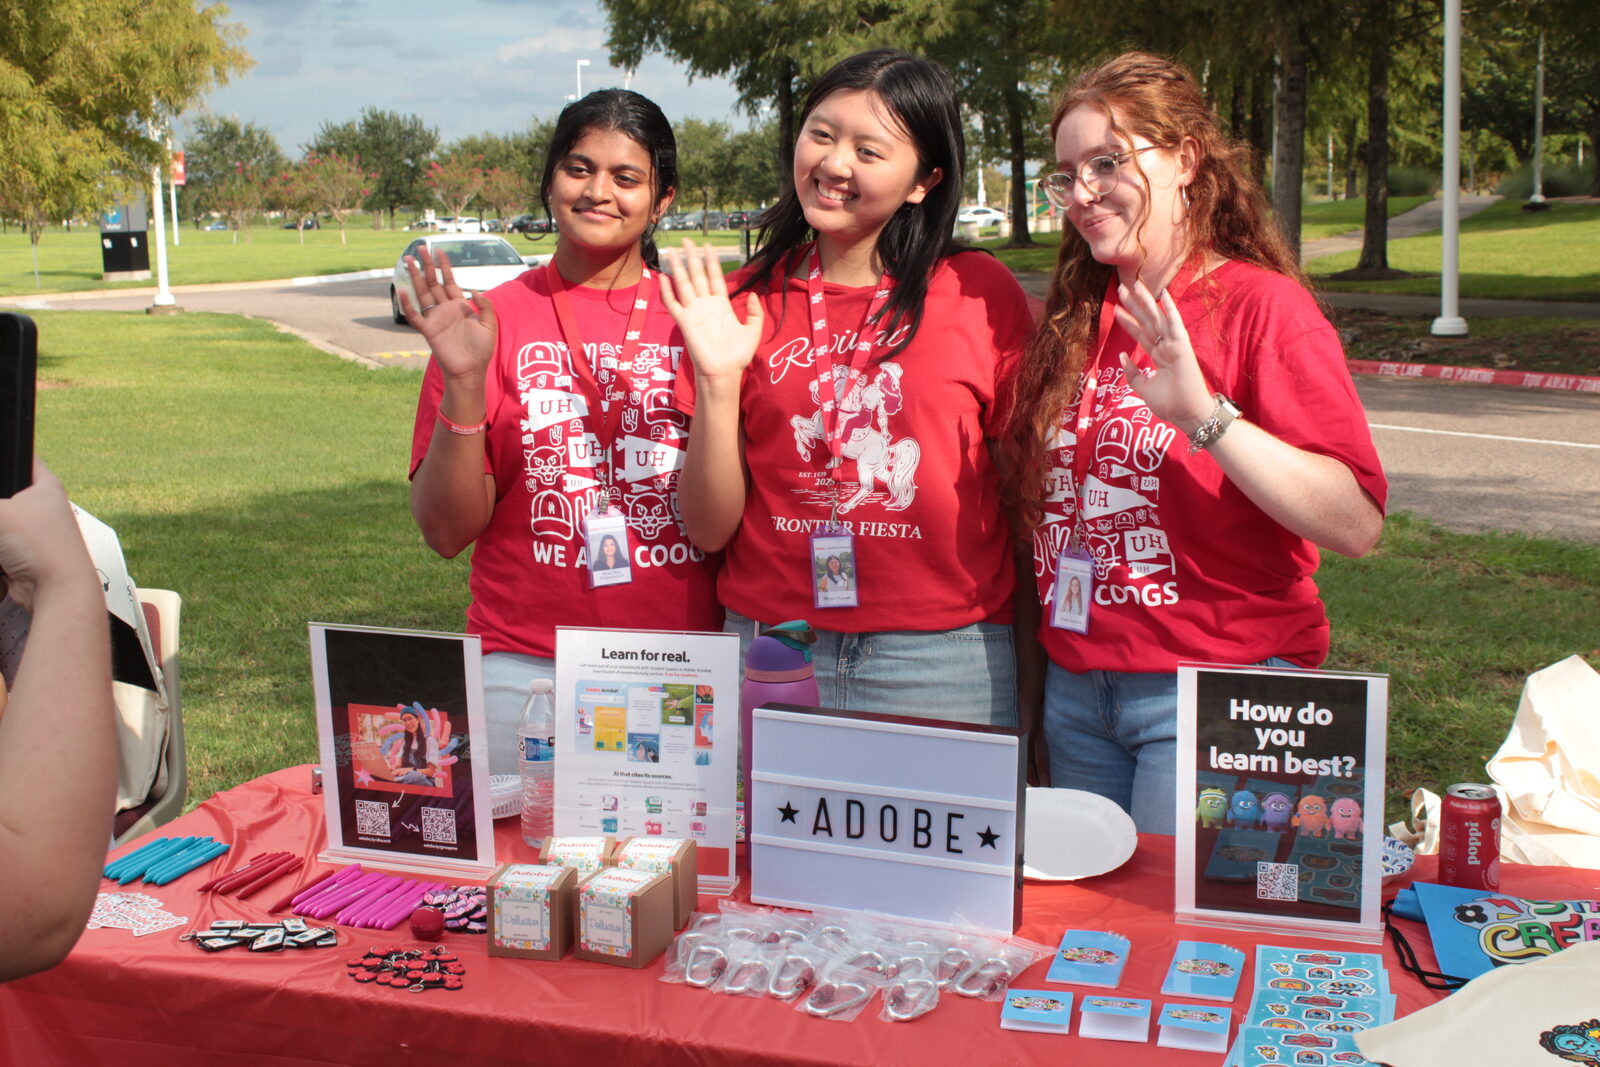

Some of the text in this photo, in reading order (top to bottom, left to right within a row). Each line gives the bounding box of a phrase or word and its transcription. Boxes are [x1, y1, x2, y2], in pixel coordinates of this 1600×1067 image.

[1378, 363, 1400, 377] FIRE
[1400, 364, 1425, 377] LANE
[1440, 367, 1453, 379] NO
[1455, 368, 1495, 384] PARKING
[1522, 374, 1545, 387] TOW
[1546, 376, 1574, 390] AWAY
[540, 399, 573, 415] UH
[575, 441, 603, 460] UH
[635, 450, 666, 468] UH
[1114, 467, 1124, 475] UH
[571, 479, 583, 487] UH
[1043, 474, 1073, 496] UH
[1143, 477, 1158, 488] UH
[1088, 489, 1109, 508] UH
[858, 521, 923, 540] FIESTA
[1131, 533, 1165, 552] UH
[532, 541, 567, 568] WE
[1135, 565, 1150, 573] UH
[601, 648, 691, 663] Learn for real.
[1230, 699, 1333, 726] How do
[1254, 727, 1306, 750] you
[1210, 746, 1357, 777] learn best?
[812, 797, 965, 854] ADOBE
[1464, 821, 1481, 865] poppi
[602, 874, 641, 884] Adobe
